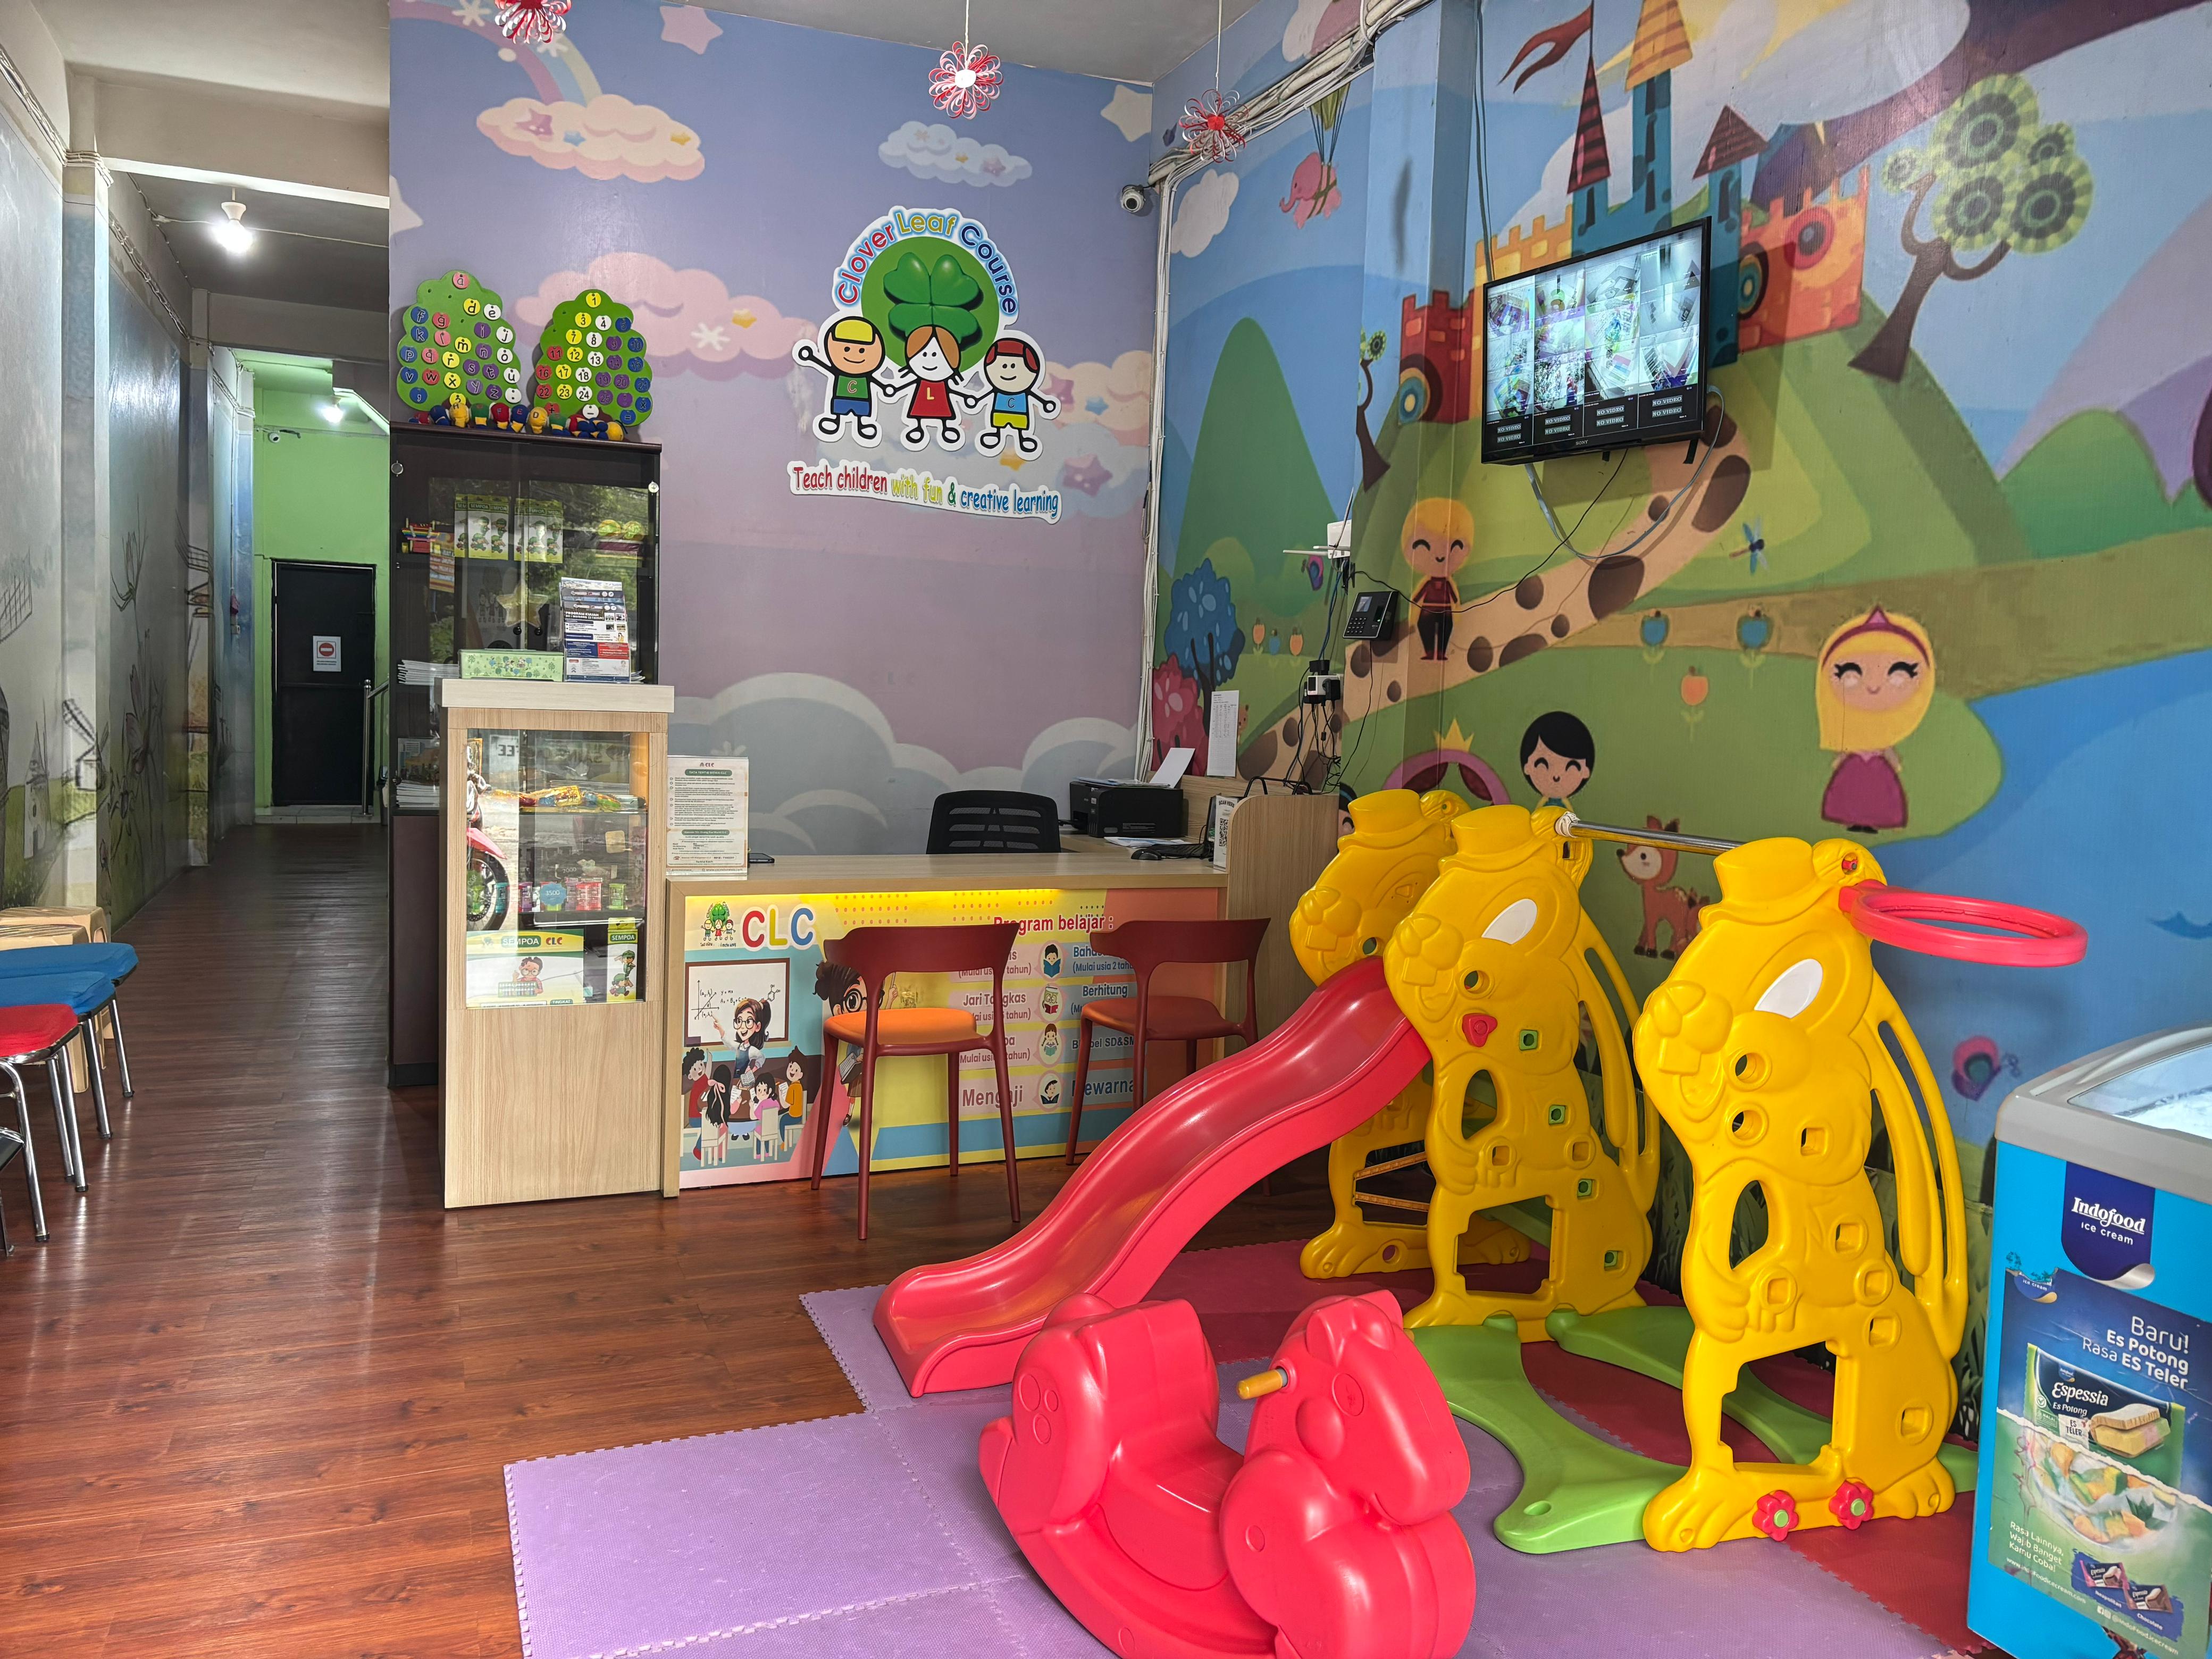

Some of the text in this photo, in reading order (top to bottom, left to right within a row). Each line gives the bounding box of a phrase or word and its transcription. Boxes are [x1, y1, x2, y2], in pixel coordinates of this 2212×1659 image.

[837, 212, 1017, 315] Clover Leaf Course
[592, 297, 597, 306] 1
[468, 303, 496, 319] d e
[417, 310, 446, 327] f g
[581, 317, 586, 325] 3
[600, 320, 606, 329] 4
[416, 328, 425, 341] k
[502, 329, 508, 342] j
[571, 334, 576, 342] 7
[591, 337, 597, 346] 8
[458, 340, 468, 351] m
[480, 348, 488, 358] n
[569, 351, 580, 361] 12
[590, 356, 601, 365] 13
[405, 349, 413, 362] p
[425, 351, 432, 362] q
[468, 363, 476, 372] s
[487, 367, 495, 379] t
[508, 373, 515, 382] u
[405, 372, 499, 399] v w x y z
[539, 368, 648, 390] 16 17 18 19 20 21
[847, 380, 858, 395] C
[926, 387, 935, 400] L
[539, 388, 610, 403] 22 23 24 25
[1007, 396, 1016, 409] C
[1663, 396, 1682, 404] VIDEO
[1663, 407, 1682, 415] VIDEO
[1554, 415, 1571, 423] VIDEO
[793, 466, 1058, 518] Teach children with fun & creative learning
[742, 908, 814, 948] CLC
[1058, 914, 1105, 933] belajar
[1007, 962, 1032, 975] tahun)
[1073, 961, 1095, 974] (Mulai
[1096, 962, 1111, 970] usia
[1083, 984, 1128, 998] Berhitung
[963, 993, 983, 1006] Jari
[1007, 1008, 1031, 1020] tahun)
[2071, 1197, 2146, 1234] Indofood
[2101, 1228, 2134, 1245] cream
[2032, 1281, 2047, 1291] cream
[2131, 1316, 2189, 1354] Baru!
[2107, 1329, 2189, 1376] Es Potong
[2082, 1337, 2189, 1389] Rasa ES Teler
[2051, 1382, 2109, 1406] Espessia
[2062, 1403, 2088, 1417] Potong
[2042, 1413, 2056, 1422] HALAL
[2071, 1419, 2076, 1428] ES
[2066, 1426, 2082, 1437] TELER
[2010, 1521, 2064, 1556] Rasa Lainnya,
[2010, 1531, 2063, 1565] Wajib Banget
[2009, 1541, 2056, 1572] Kamu Coba!
